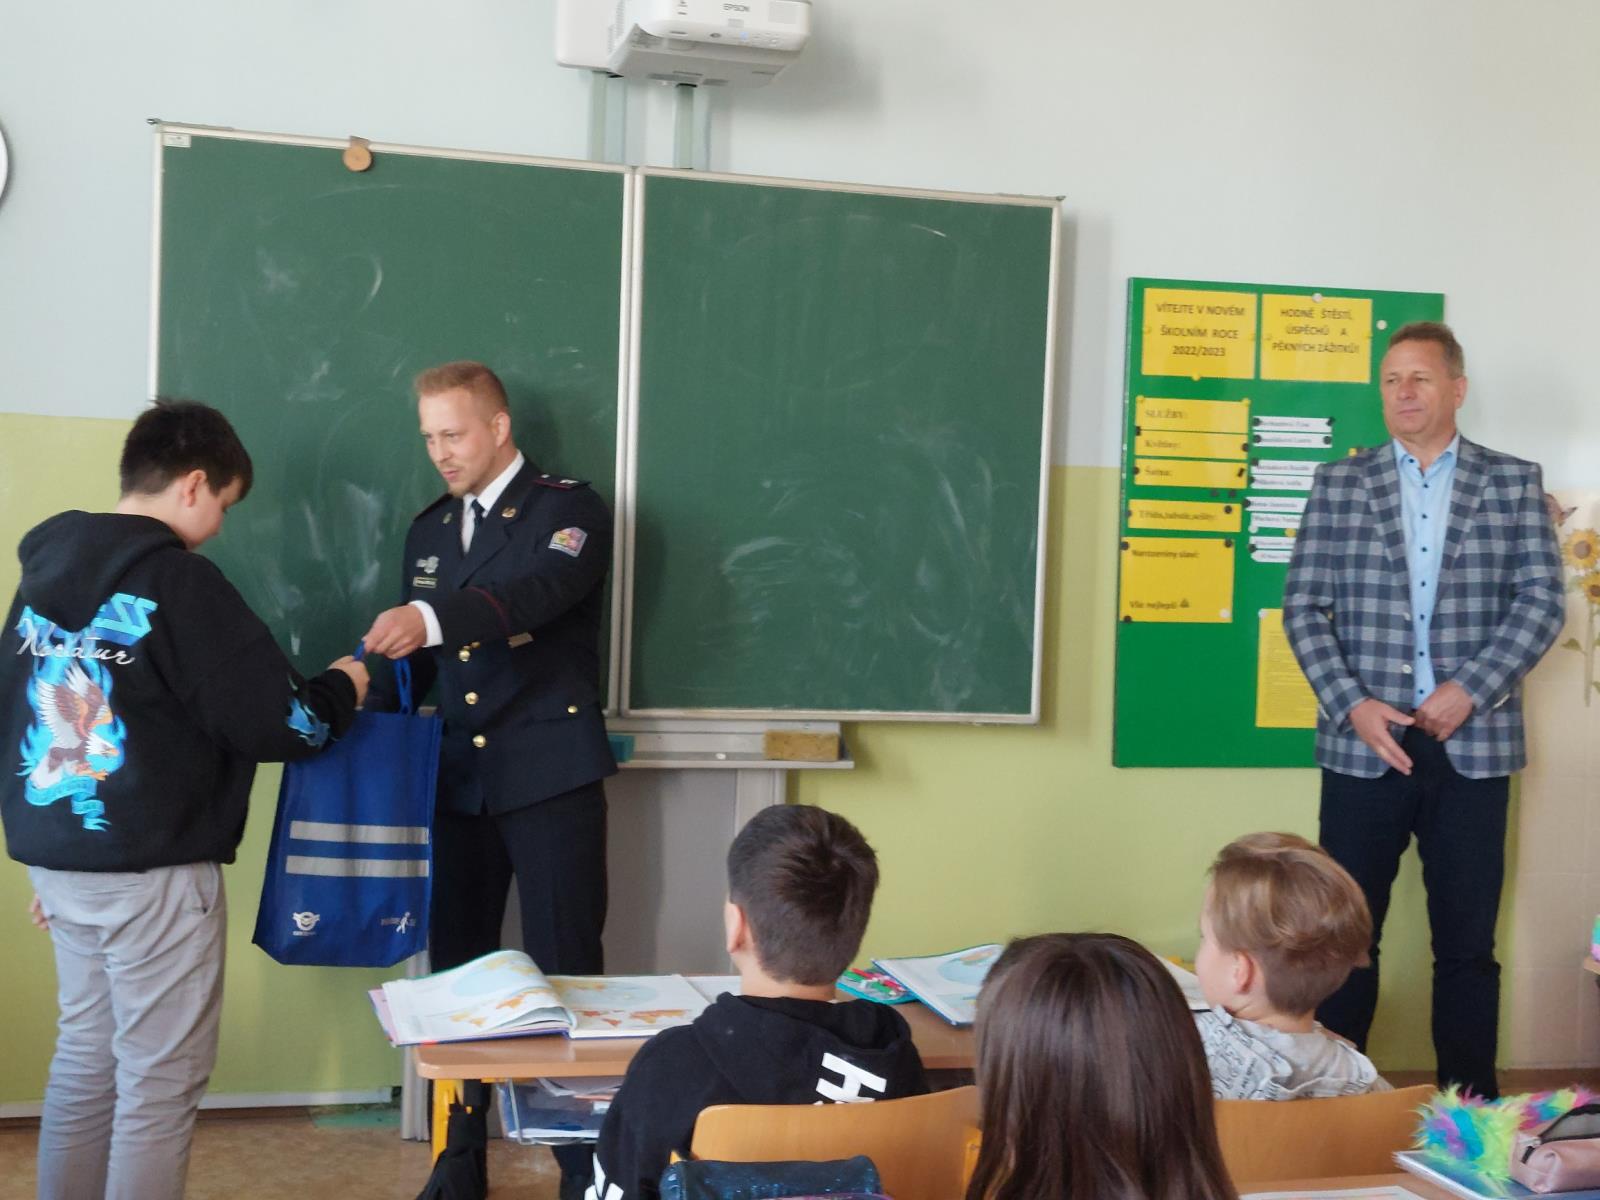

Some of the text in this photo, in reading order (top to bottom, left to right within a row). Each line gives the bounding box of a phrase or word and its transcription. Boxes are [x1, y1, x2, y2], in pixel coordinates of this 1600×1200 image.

[1156, 302, 1245, 316] VÍTEJTE V NOVÉM
[1160, 325, 1239, 340] ŠKOLNÍM ROCE
[1286, 323, 1348, 337] ÚSPĚCHŮ A
[1172, 345, 1226, 358] 2022/2023
[1272, 340, 1316, 353] PĚKNÝCH
